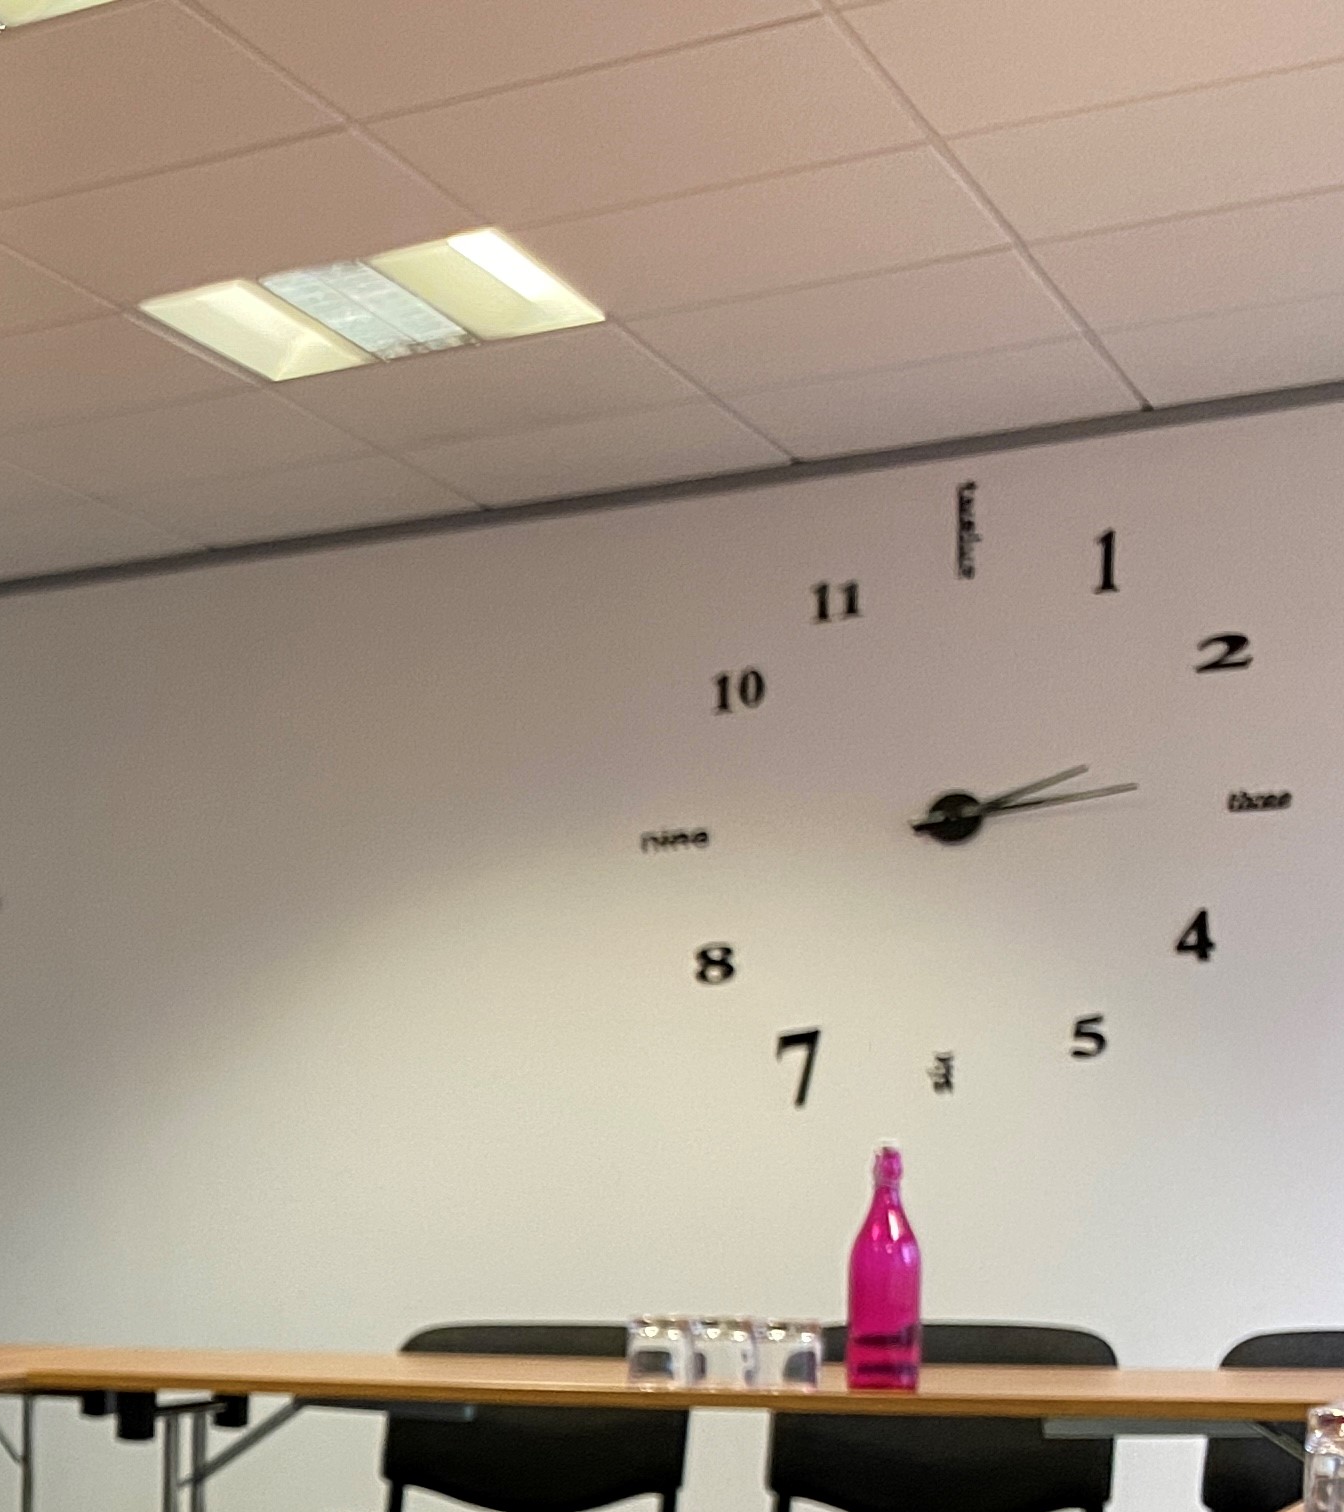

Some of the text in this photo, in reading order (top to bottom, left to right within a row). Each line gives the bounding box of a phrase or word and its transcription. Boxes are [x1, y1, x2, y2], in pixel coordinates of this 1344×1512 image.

[1093, 528, 1120, 595] 1
[811, 579, 863, 626] 11
[1195, 632, 1254, 674] 2
[712, 665, 767, 716] 10
[1175, 907, 1216, 962] 4
[695, 943, 736, 985] 8
[1071, 1013, 1107, 1059] 5
[777, 1026, 820, 1107] 7
